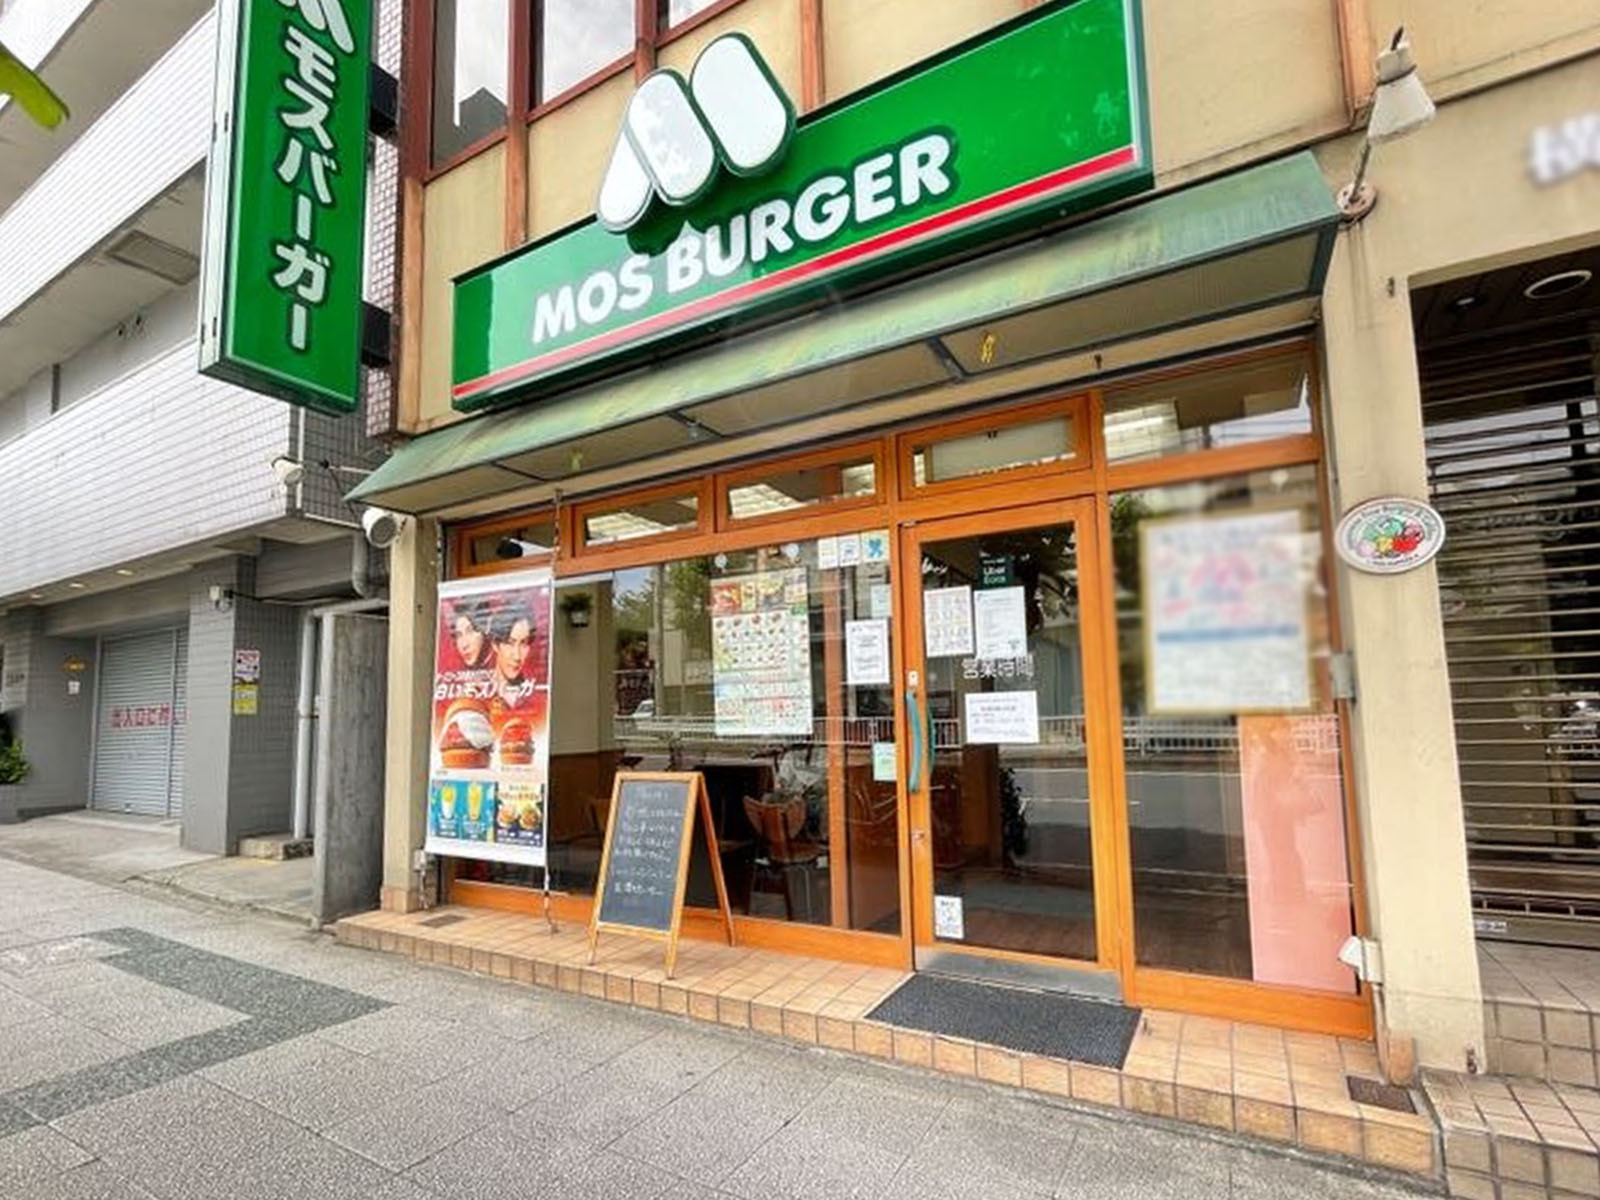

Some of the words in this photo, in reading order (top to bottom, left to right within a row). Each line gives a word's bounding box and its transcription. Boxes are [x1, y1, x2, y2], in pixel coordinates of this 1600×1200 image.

[273, 25, 338, 351] モスバーガー
[531, 253, 655, 345] MOS
[666, 133, 952, 294] BURGER
